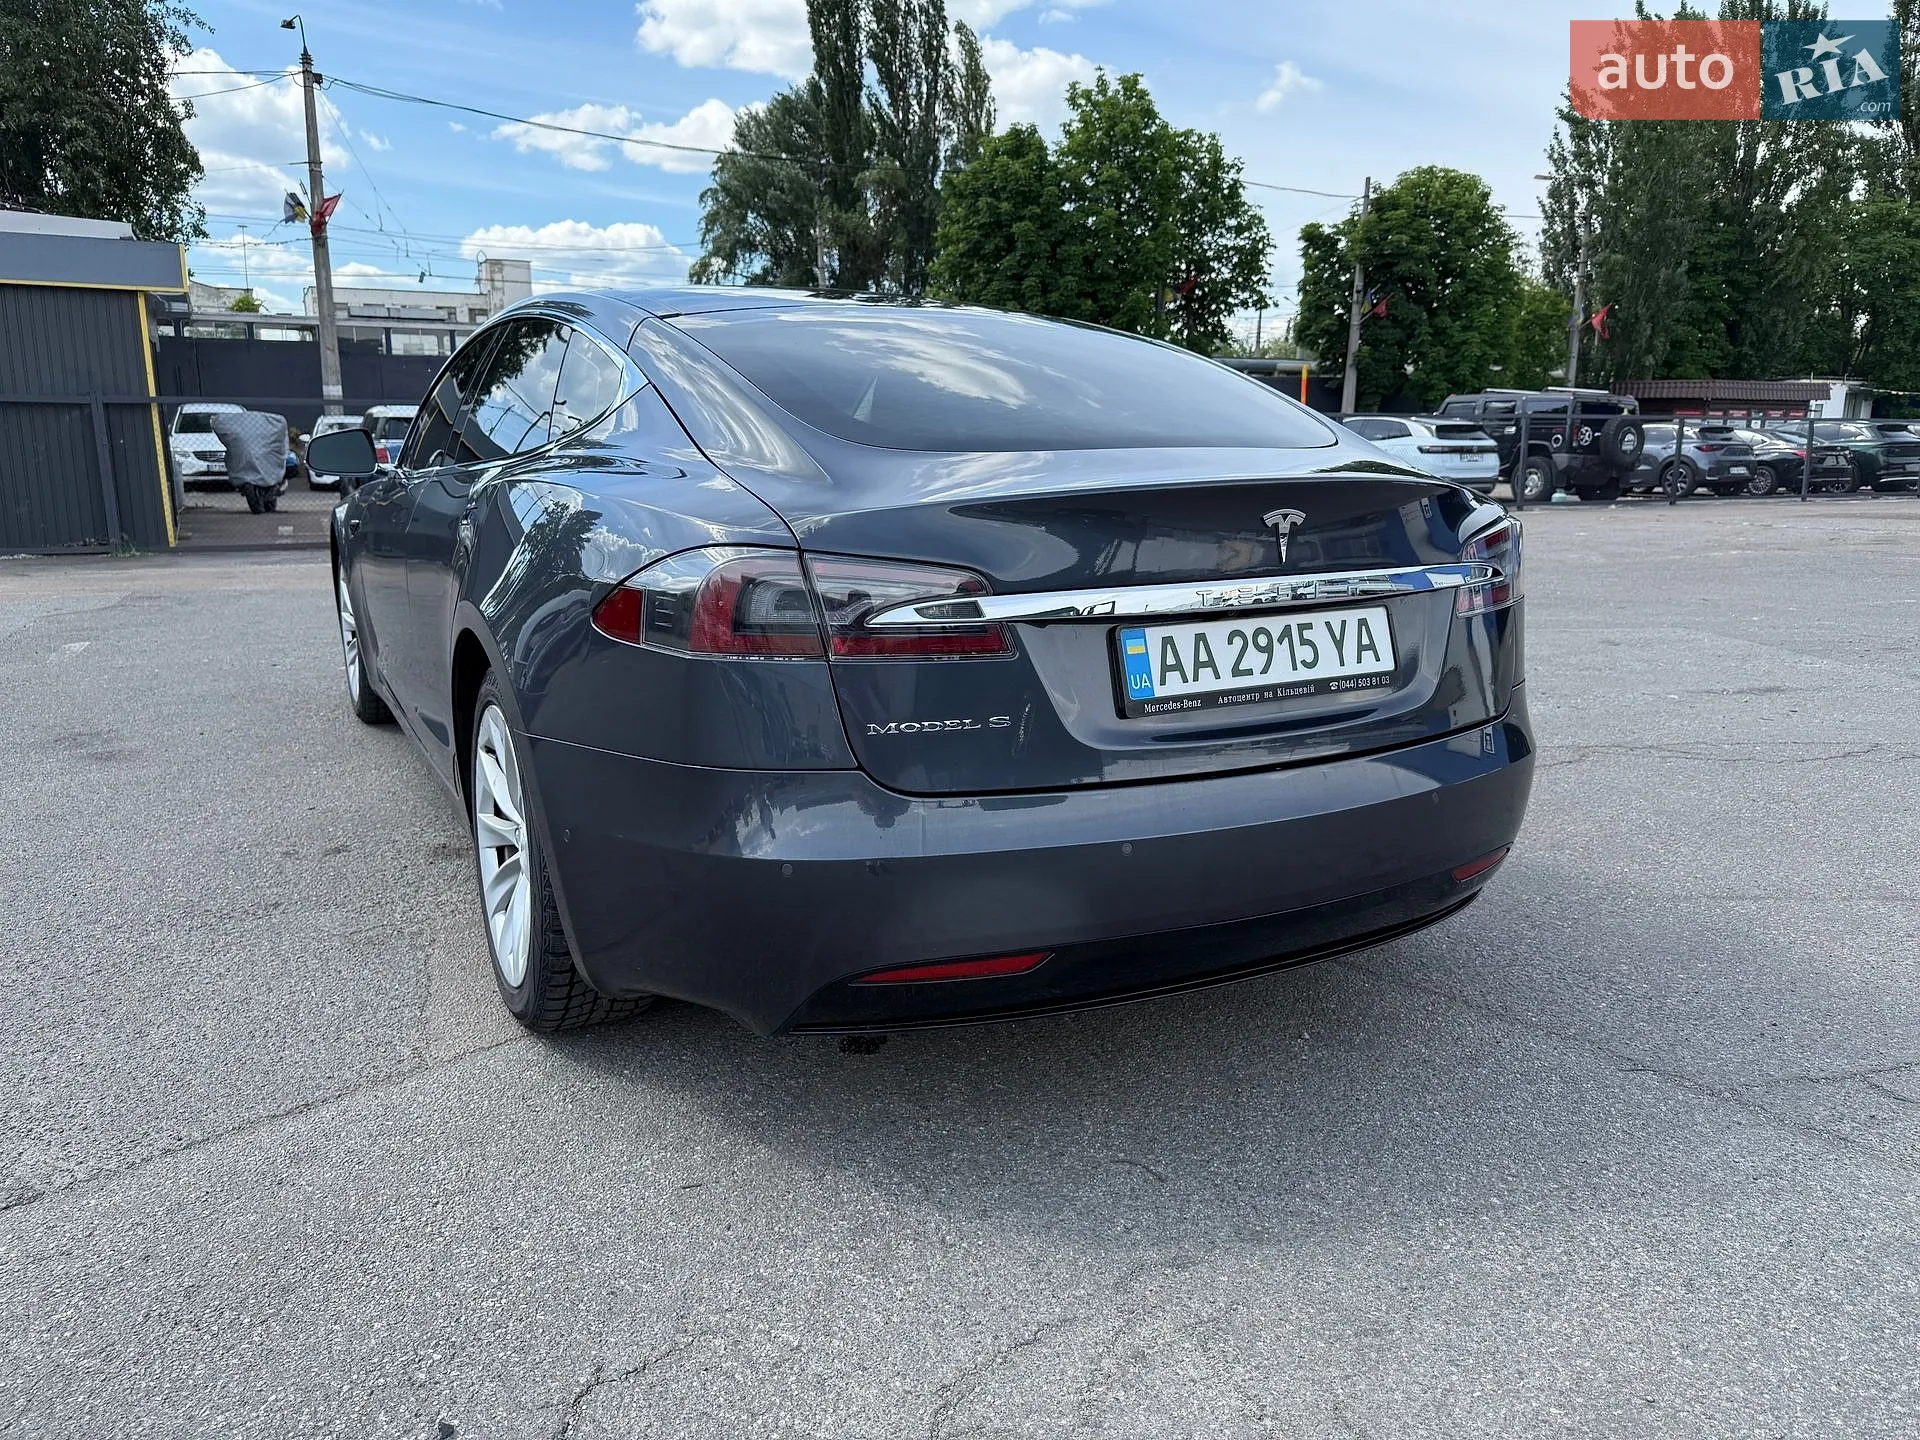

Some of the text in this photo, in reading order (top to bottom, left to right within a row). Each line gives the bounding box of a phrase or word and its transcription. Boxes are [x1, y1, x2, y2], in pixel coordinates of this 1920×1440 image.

[1159, 617, 1381, 687] AA 2915 YA
[1130, 672, 1151, 690] UA
[1339, 675, 1390, 690] (044) 503 81 03
[1217, 683, 1316, 705] Автоцентр на Кільцевій
[1144, 698, 1202, 714] Mercedes-Benz
[866, 716, 1011, 736] MODEL S
